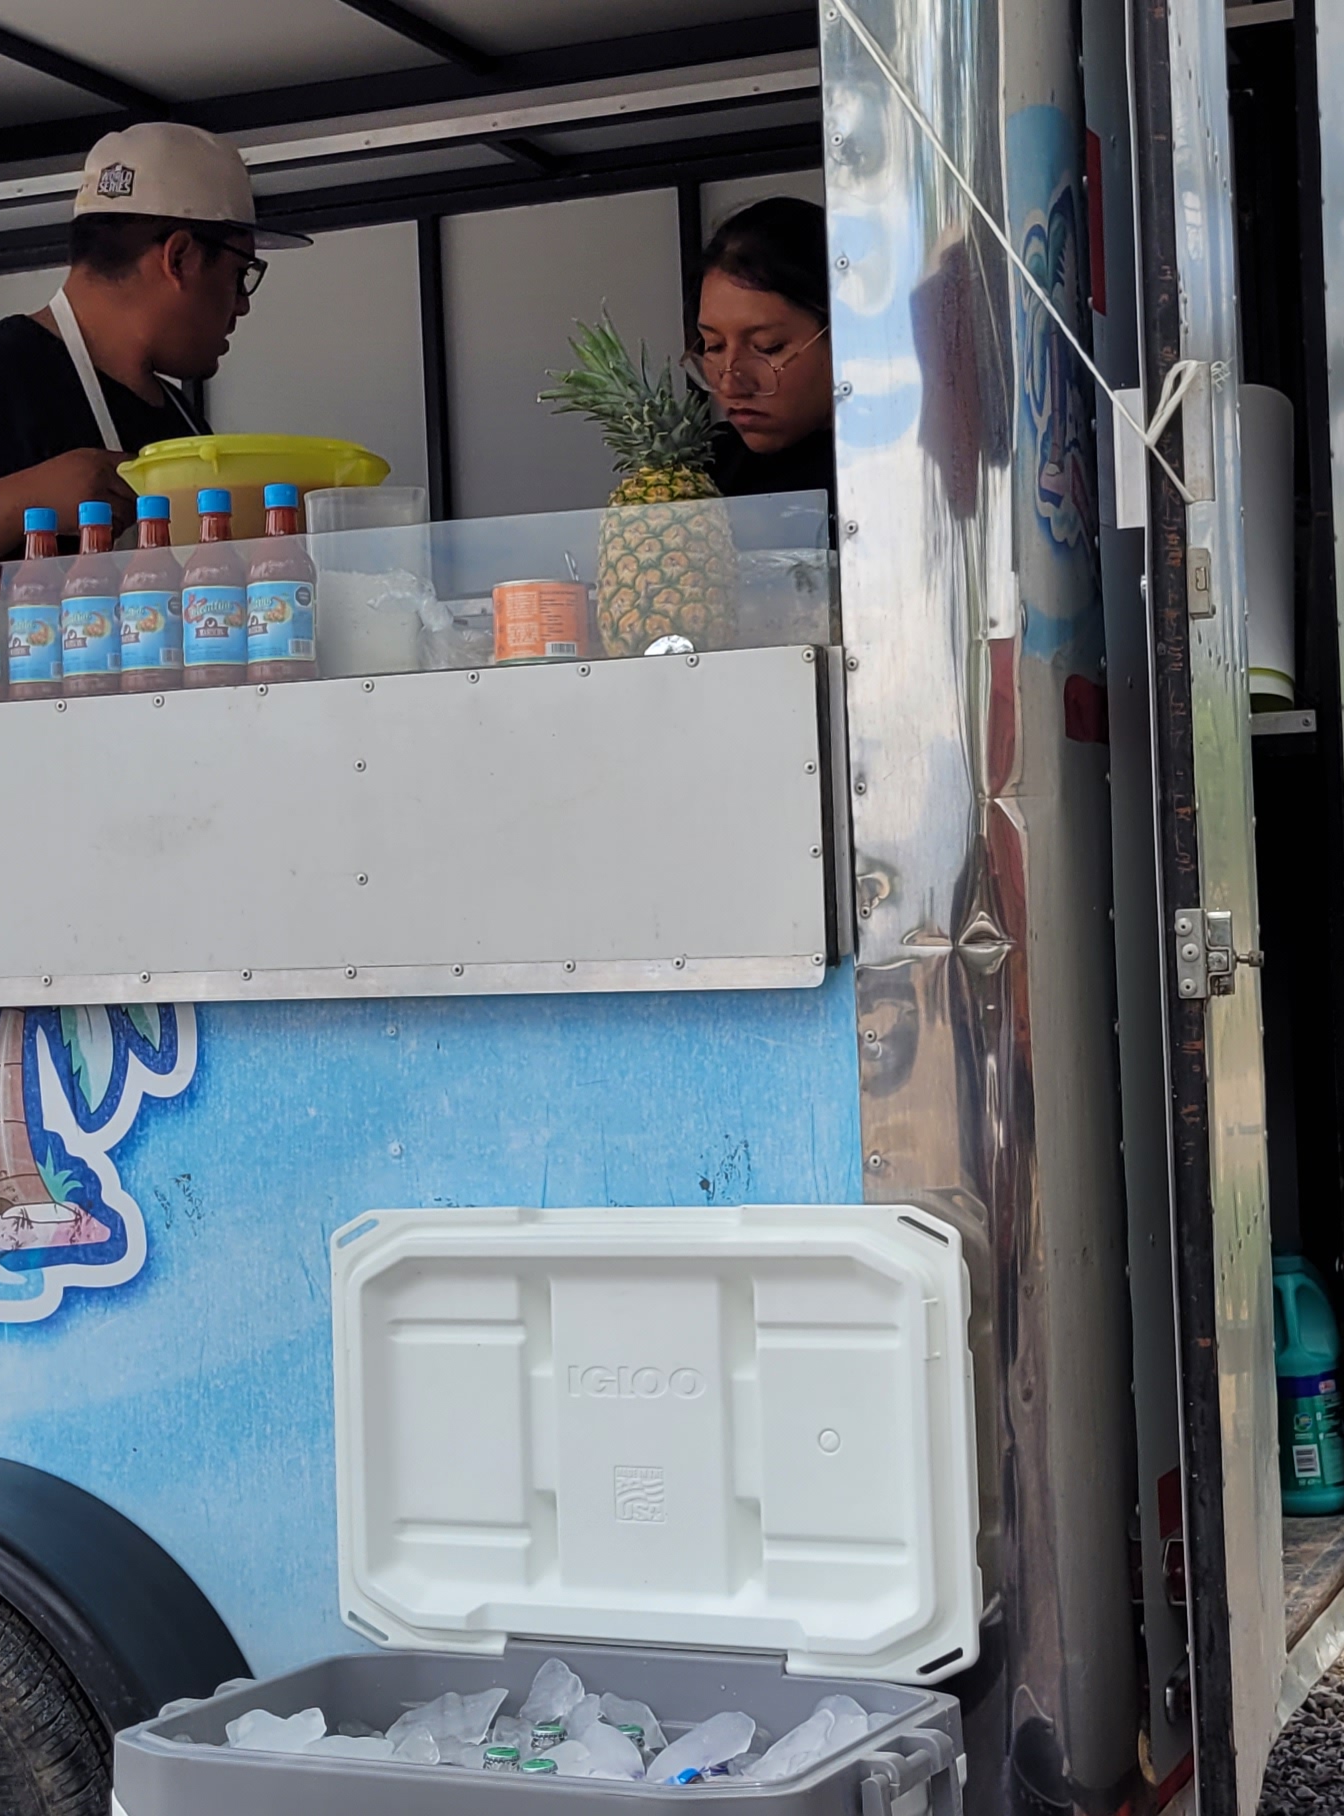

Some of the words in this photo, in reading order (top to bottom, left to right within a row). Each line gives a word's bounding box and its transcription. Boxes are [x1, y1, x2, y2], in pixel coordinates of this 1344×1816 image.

[100, 170, 133, 183] WORLD
[97, 181, 131, 194] SERIES
[567, 1364, 708, 1400] IGLOO
